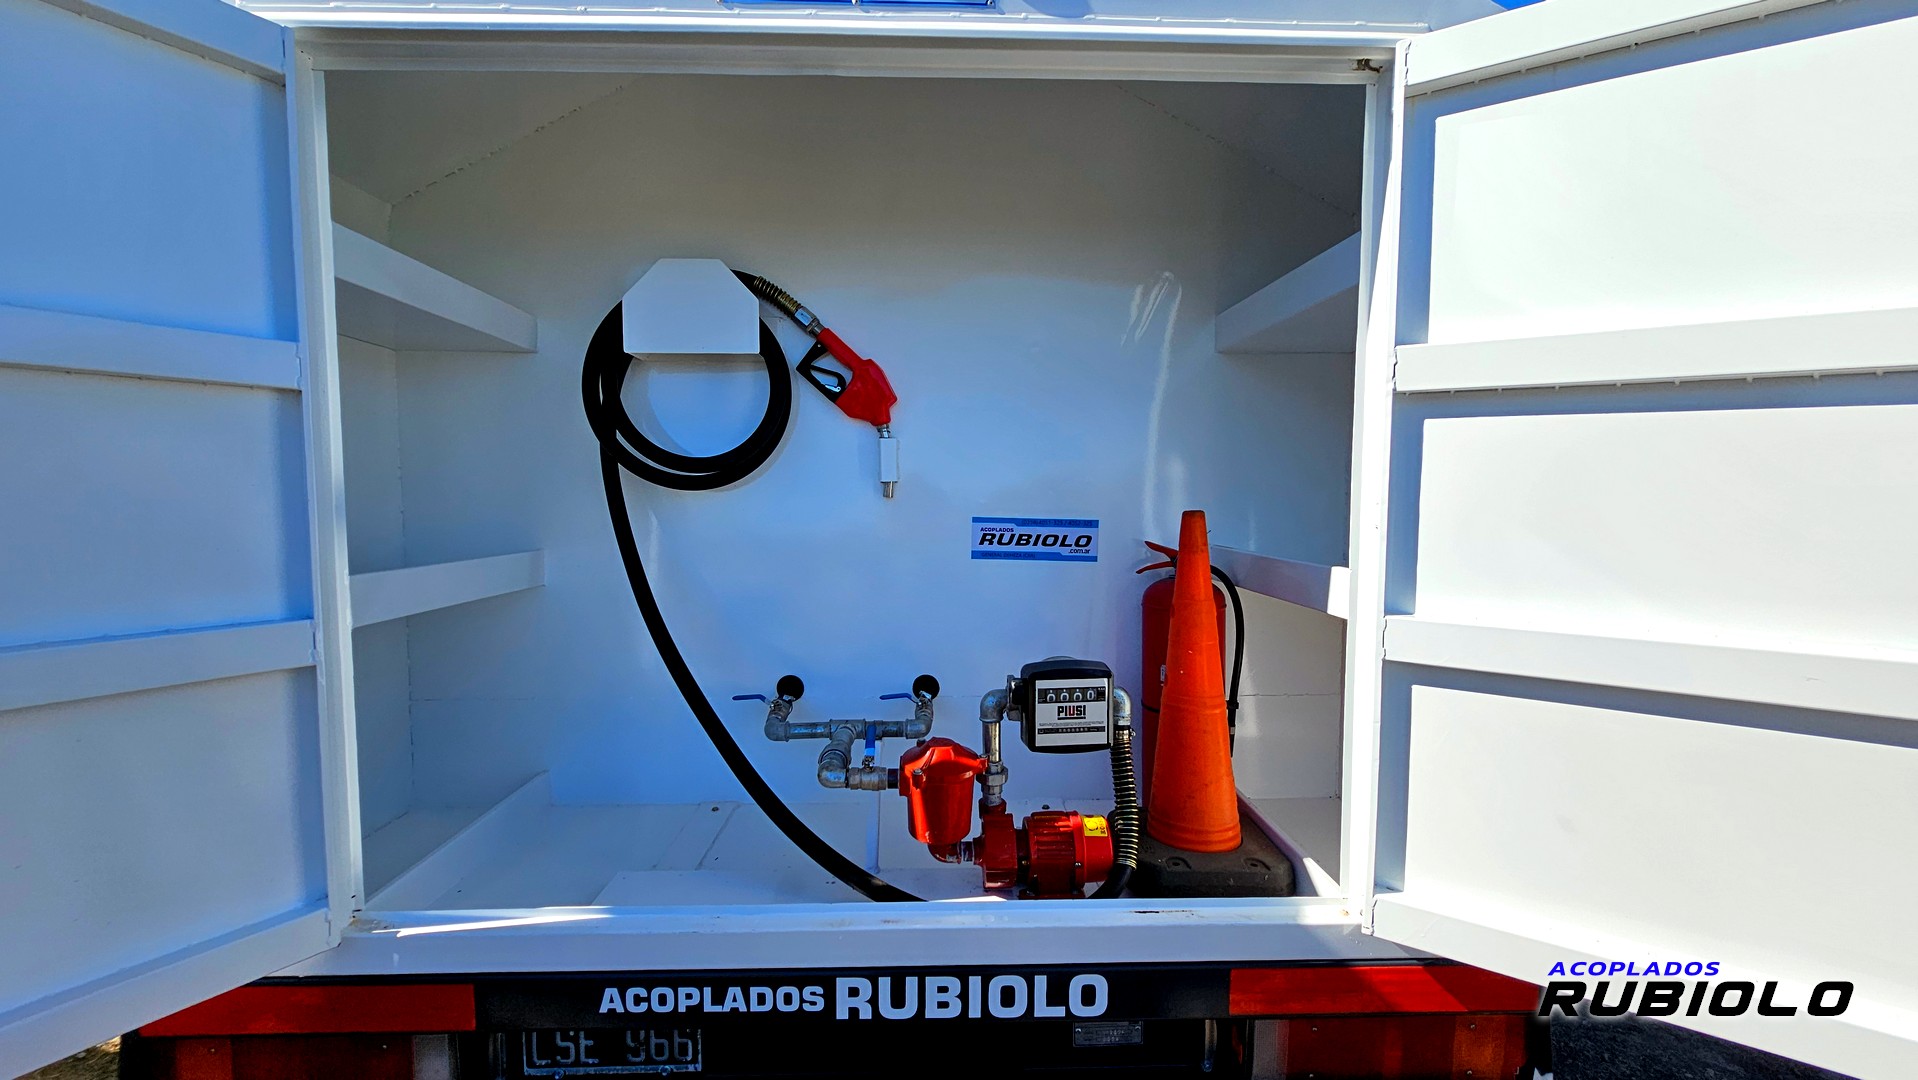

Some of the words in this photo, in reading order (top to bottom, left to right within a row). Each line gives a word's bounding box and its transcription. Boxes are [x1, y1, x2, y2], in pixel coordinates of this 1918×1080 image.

[979, 533, 1093, 548] RUBIOLO
[1057, 705, 1086, 716] PIUSI
[599, 986, 825, 1014] ACOPLADOS
[835, 974, 1109, 1020] RUBIOLO
